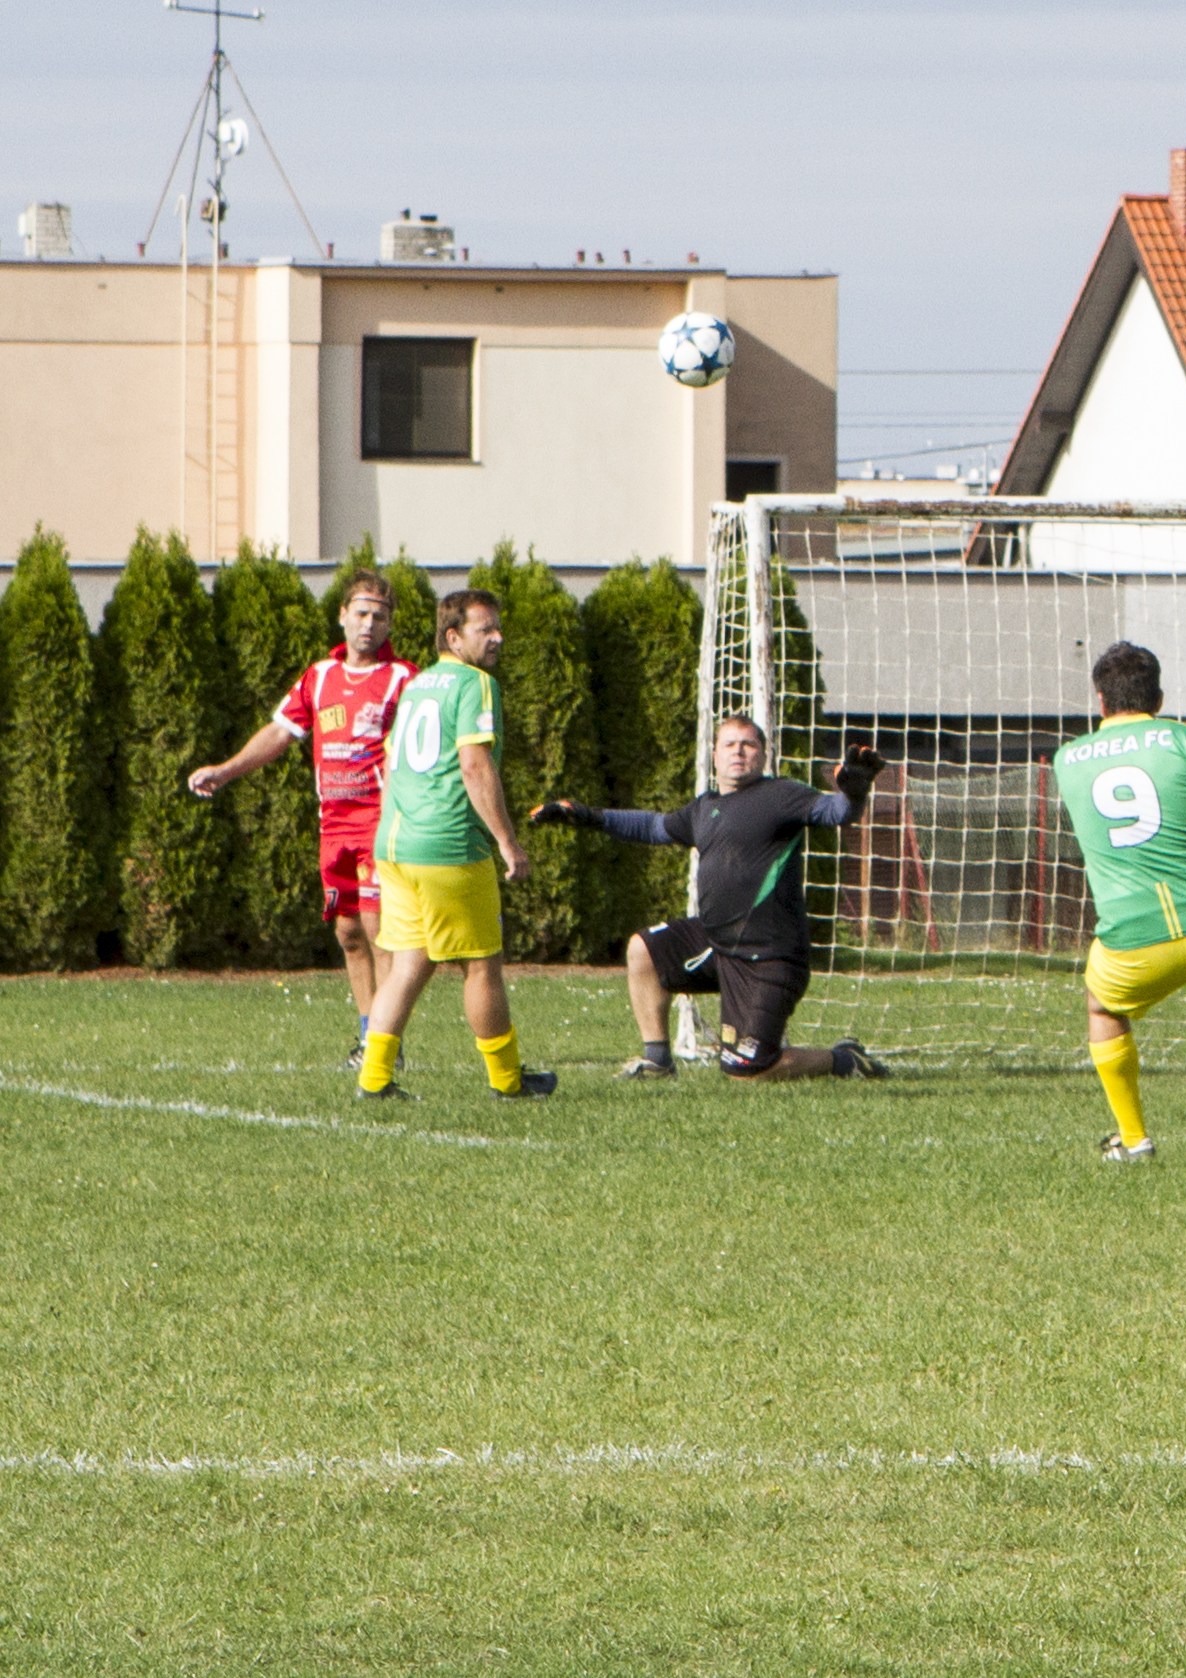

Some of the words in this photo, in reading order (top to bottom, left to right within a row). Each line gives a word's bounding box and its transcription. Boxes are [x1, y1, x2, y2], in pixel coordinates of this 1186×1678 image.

[391, 698, 441, 774] 10
[1065, 735, 1139, 765] KOREA
[1144, 729, 1172, 748] FC
[1092, 765, 1162, 848] 9
